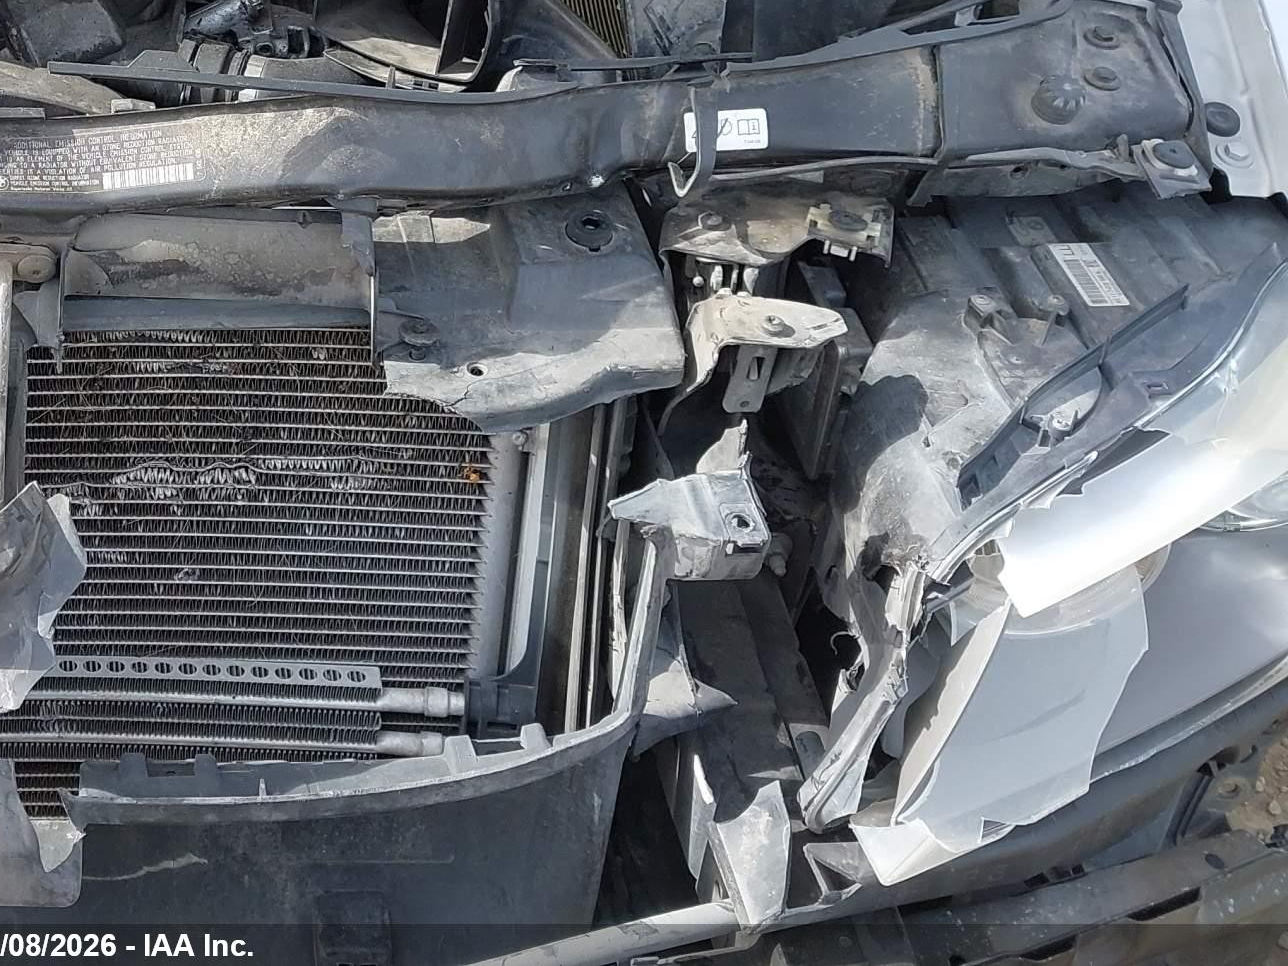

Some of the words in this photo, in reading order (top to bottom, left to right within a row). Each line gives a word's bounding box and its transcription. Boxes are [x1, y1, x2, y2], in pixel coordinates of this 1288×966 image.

[54, 137, 85, 147] EMISSION
[88, 134, 119, 145] CONTROL
[72, 146, 88, 154] WITH
[91, 144, 100, 152] AN
[102, 143, 121, 151] OZONE
[123, 139, 155, 148] REDUCTION
[70, 158, 96, 167] WITHOUT
[100, 154, 136, 165] EQUIVALENT
[139, 152, 156, 161] OZONE
[160, 148, 193, 158] REDUCTION
[82, 151, 107, 160] VEHICLE
[110, 148, 138, 157] EMISSION
[140, 145, 166, 154] CONTROL
[104, 162, 136, 172] POLLUTION
